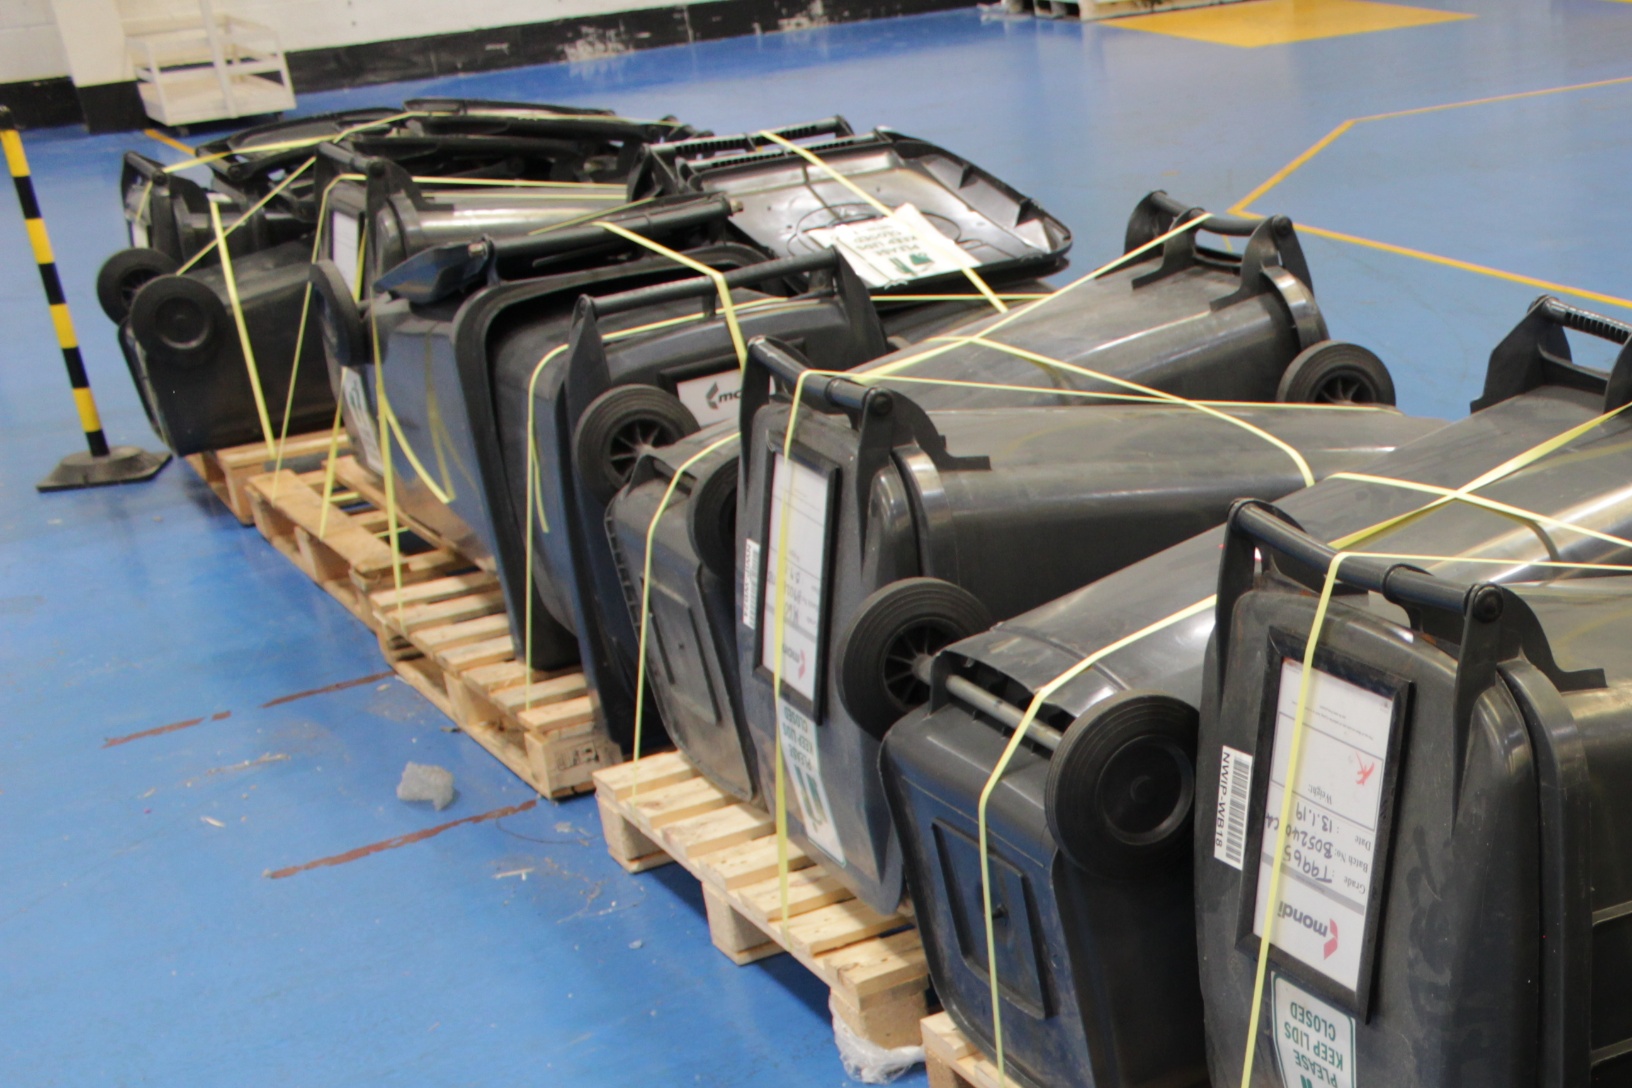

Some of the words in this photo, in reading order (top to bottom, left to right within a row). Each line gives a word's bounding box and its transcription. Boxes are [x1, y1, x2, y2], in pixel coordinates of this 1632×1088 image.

[1216, 751, 1230, 848] NWIP-WB18
[1307, 782, 1332, 804] Weight:
[1333, 847, 1346, 861] No:
[1354, 834, 1370, 850] Date
[1348, 854, 1368, 872] Batch
[1343, 875, 1365, 895] Grade
[1278, 900, 1327, 938] mondi
[1290, 1002, 1336, 1042] CLOSED
[1283, 1022, 1310, 1051] LIDS
[1313, 1041, 1343, 1071] KEEP
